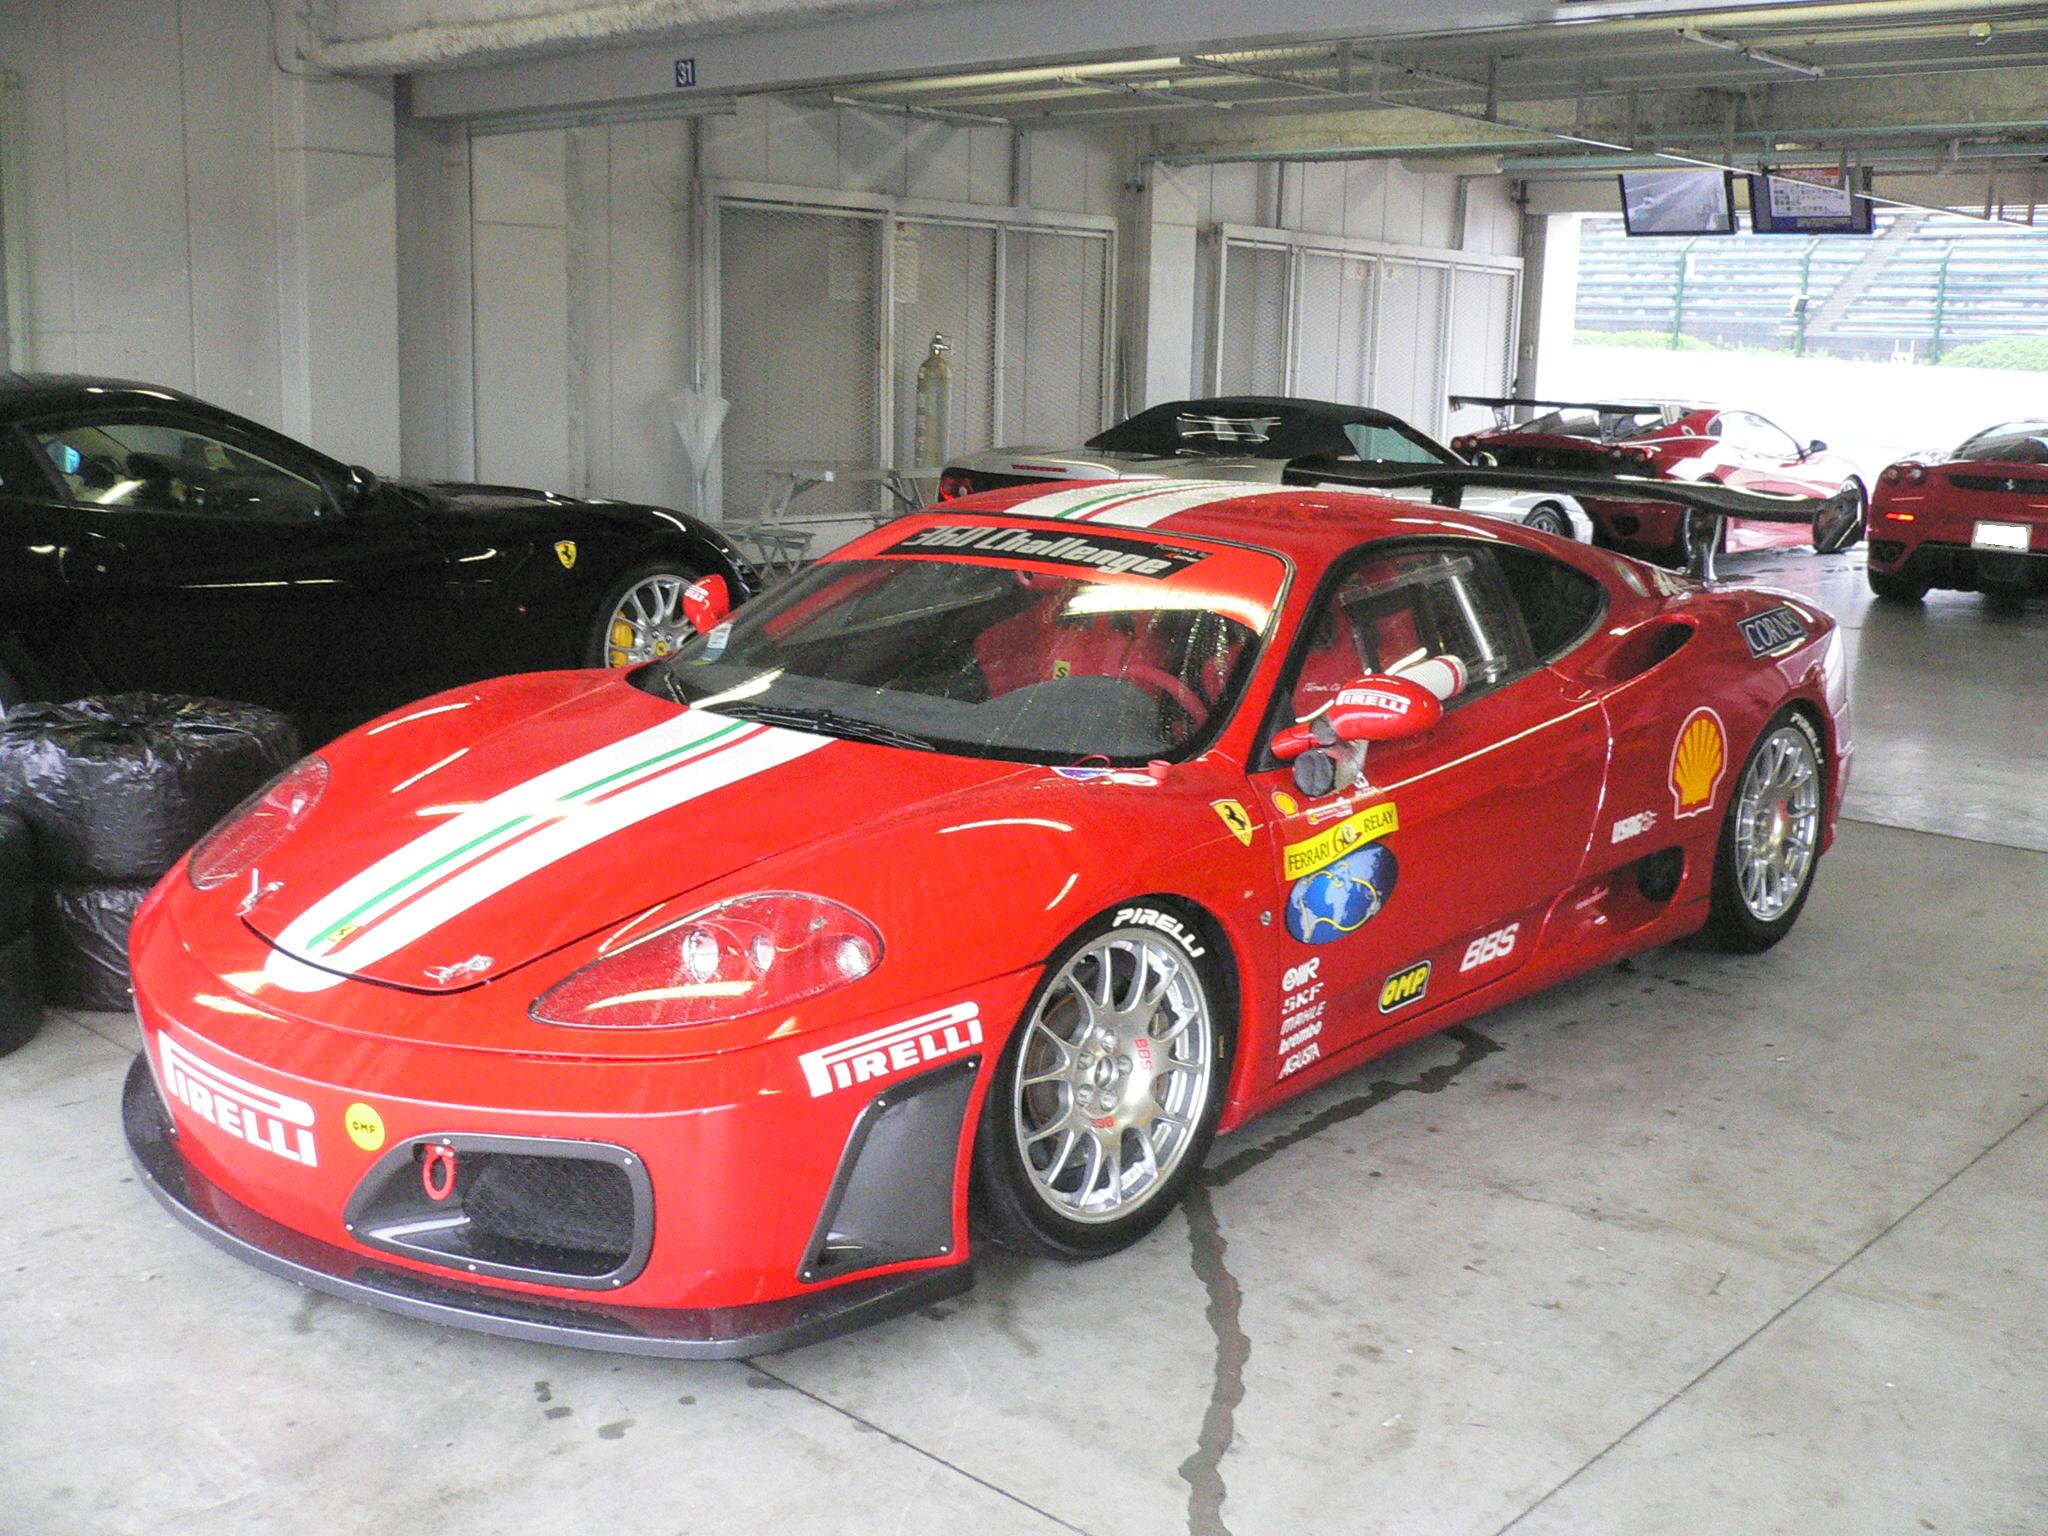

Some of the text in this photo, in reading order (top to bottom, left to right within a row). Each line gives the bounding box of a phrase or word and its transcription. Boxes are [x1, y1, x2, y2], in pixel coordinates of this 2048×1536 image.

[677, 61, 693, 85] 31
[901, 525, 998, 548] 360
[973, 528, 1172, 575] Challenge
[1335, 688, 1411, 714] PIRELLI
[1287, 841, 1330, 872] FERRARI
[1363, 809, 1394, 833] RELAY
[1112, 907, 1205, 958] PIRELLI
[1459, 922, 1520, 972] BBS
[1282, 982, 1324, 1015] SKF
[1382, 966, 1429, 1006] OMP
[798, 1001, 984, 1098] PIRELLI
[1278, 1020, 1323, 1055] brembo
[158, 1029, 319, 1168] PIRELLI
[352, 1120, 376, 1134] OMP
